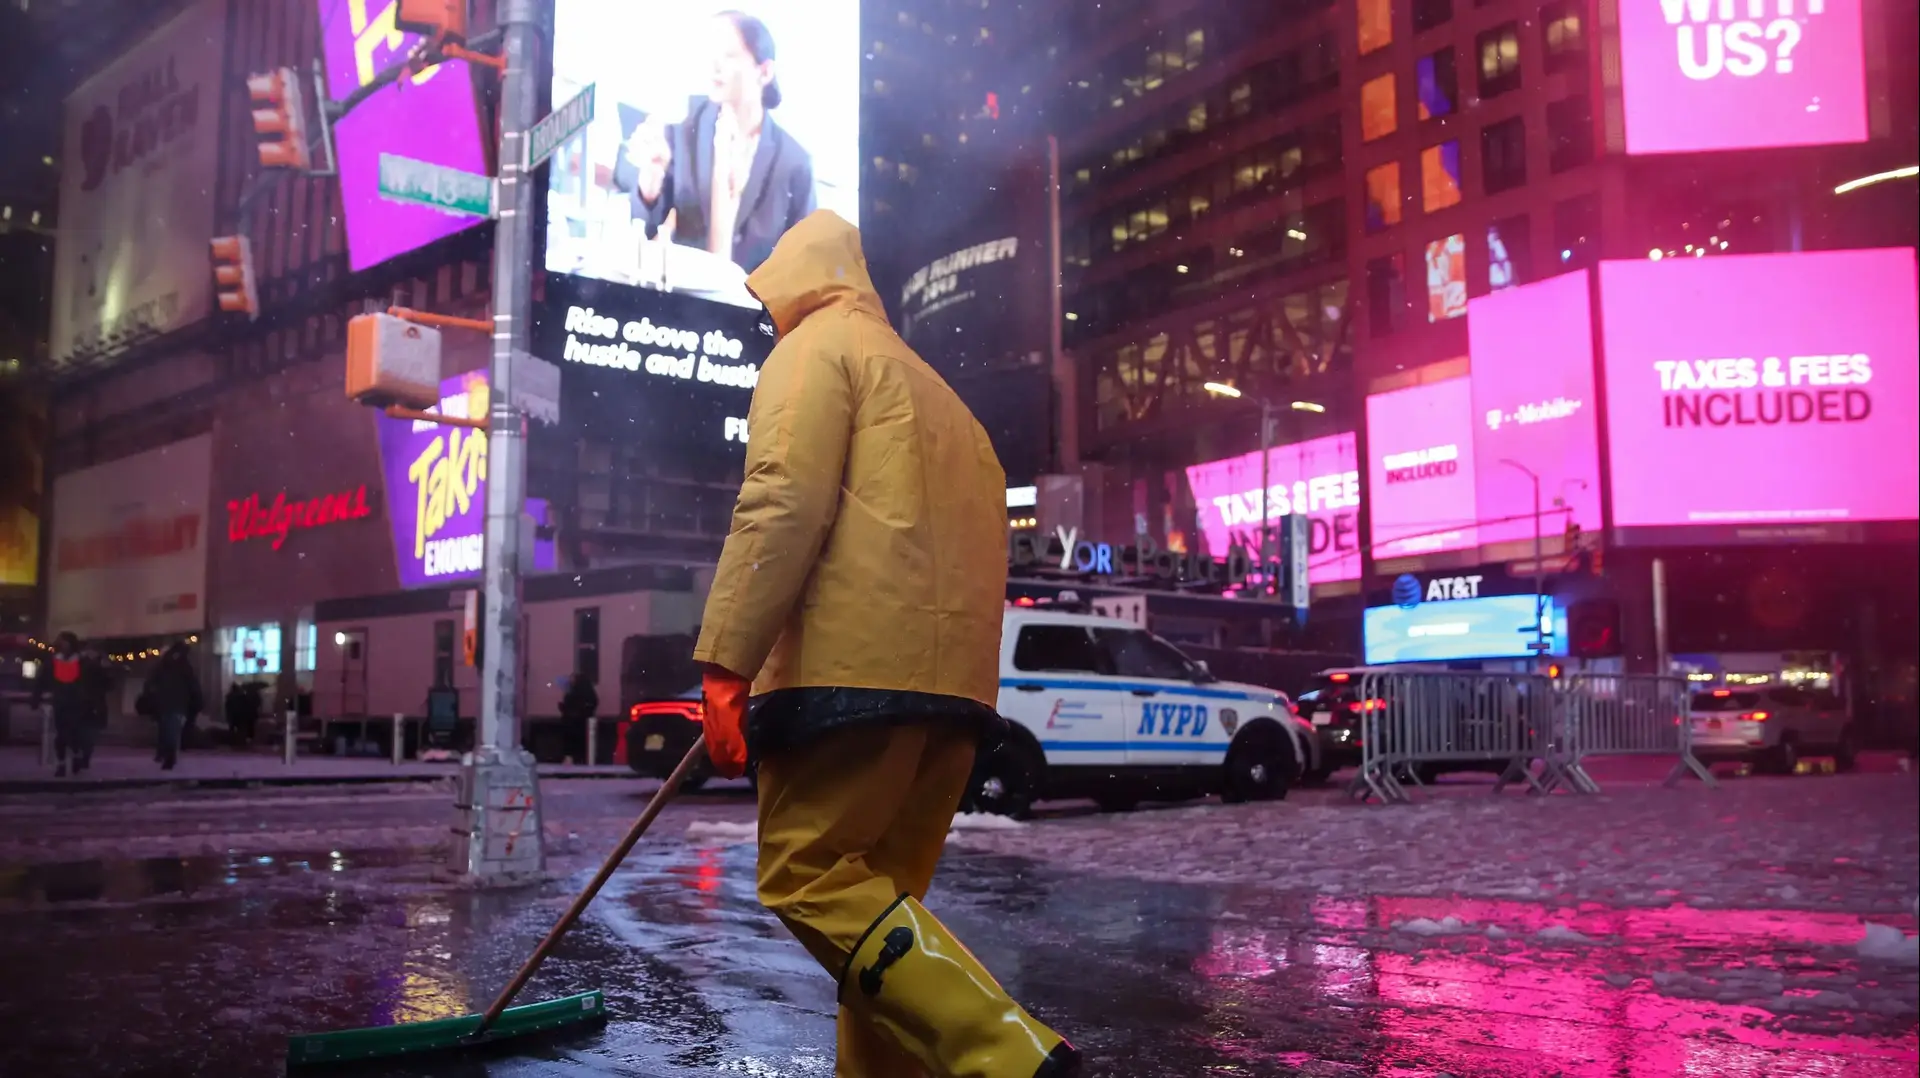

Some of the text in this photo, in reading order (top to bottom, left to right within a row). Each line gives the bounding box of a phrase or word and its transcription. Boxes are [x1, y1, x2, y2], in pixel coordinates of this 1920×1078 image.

[1677, 18, 1801, 80] US?
[533, 90, 592, 161] BROADWAY
[565, 306, 743, 359] Rise above the
[564, 334, 641, 371] hustle
[645, 353, 695, 379] and
[1654, 354, 1873, 390] TAXES & FEES
[1663, 389, 1872, 427] INCLUDED
[1386, 460, 1457, 485] INCLUDED
[227, 485, 371, 550] Walgreens
[1427, 576, 1482, 601] AT&T
[1137, 703, 1208, 736] NYPD
